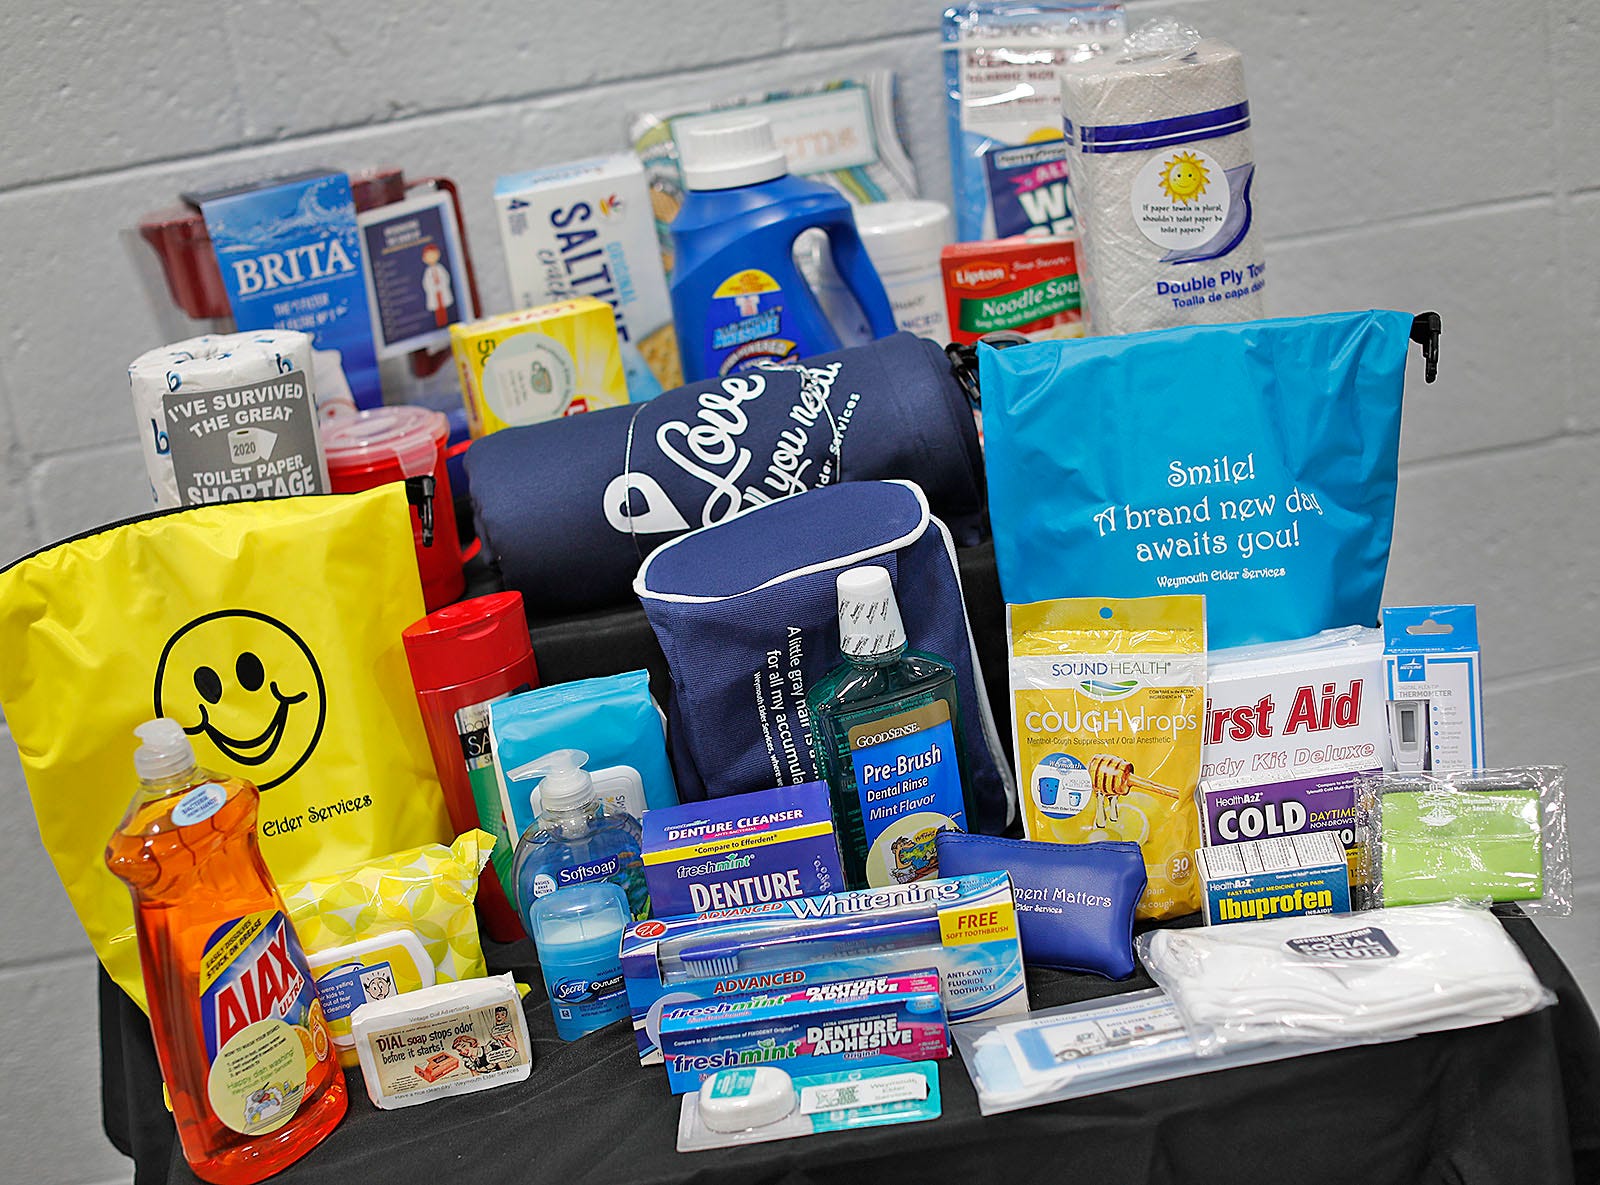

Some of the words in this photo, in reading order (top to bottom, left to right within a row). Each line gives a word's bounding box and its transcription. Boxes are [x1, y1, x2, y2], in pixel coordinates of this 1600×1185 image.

[1151, 205, 1169, 214] paper
[1194, 216, 1212, 224] paper
[231, 238, 357, 296] BRITA
[551, 202, 631, 342] SALTI
[955, 268, 1005, 286] Lipton
[1156, 275, 1217, 295] Double
[1220, 269, 1243, 285] Ply
[981, 288, 1045, 318] Noodle
[1046, 279, 1080, 300] Sou
[1172, 294, 1206, 308] Toalla
[1208, 292, 1222, 303] de
[1225, 286, 1249, 299] capa
[168, 399, 208, 423] I'VE
[212, 383, 304, 411] SURVIVED
[189, 414, 230, 438] THE
[235, 406, 293, 425] GREAT
[829, 392, 861, 456] Services
[233, 441, 256, 457] 2020
[193, 467, 252, 487] TOILET
[256, 454, 304, 478] PAPER
[764, 426, 813, 496] you
[1167, 452, 1256, 488] Smile!
[1093, 505, 1118, 537] A
[1123, 495, 1211, 531] brand
[1219, 494, 1276, 522] new
[1285, 486, 1324, 516] day
[1136, 531, 1228, 563] awaits
[1237, 519, 1301, 559] you!
[1157, 570, 1209, 588] Weymouth
[1210, 568, 1240, 582] Elder
[1242, 566, 1287, 580] Services
[787, 626, 802, 638] A
[766, 649, 782, 669] for
[788, 638, 804, 667] little
[769, 671, 785, 688] all
[1052, 663, 1108, 677] SOUND
[787, 671, 805, 698] gray
[1399, 690, 1453, 698] THERMOMETER
[770, 690, 785, 711] my
[757, 704, 769, 724] Elder
[1025, 710, 1123, 733] COUGH
[1131, 705, 1197, 741] drops
[1203, 693, 1275, 746] irst
[1282, 679, 1364, 736] Aid
[775, 713, 806, 786] accumula
[1026, 736, 1072, 746] Menthol-Cough
[1073, 737, 1115, 746] Suppressant
[1121, 737, 1136, 745] Oral
[1136, 735, 1171, 745] Anesthetic
[863, 743, 942, 785] Pre-Brush
[1201, 757, 1245, 778] ndy
[1252, 750, 1288, 771] Kit
[1294, 743, 1375, 766] Deluxe
[867, 783, 901, 802] Dental
[902, 776, 929, 793] Rinse
[262, 812, 304, 839] Elder
[308, 793, 373, 824] Services
[869, 805, 898, 821] Mint
[899, 793, 937, 814] Flavor
[1310, 807, 1357, 823] DAYTIME
[668, 820, 733, 841] DENTURE
[736, 809, 804, 829] CLEANSER
[1217, 801, 1307, 841] COLD
[731, 841, 740, 849] to
[560, 860, 616, 882] Softsoap
[677, 852, 750, 879] freshmint
[1172, 857, 1189, 873] 30
[689, 869, 804, 913] DENTURE
[1014, 887, 1049, 901] ment
[1052, 887, 1112, 908] Matters
[1244, 887, 1265, 895] RELIEF
[1266, 883, 1295, 892] MEDICINE
[697, 902, 783, 921] ADVANCED
[786, 881, 961, 919] Whitening
[1034, 904, 1063, 914] Services
[1149, 900, 1175, 911] cough
[1219, 889, 1333, 920] Ibuprofen
[958, 911, 998, 929] FREE
[946, 931, 963, 940] SOFT
[964, 925, 1009, 938] TOOTHBRUSH
[216, 919, 300, 1048] AJAX
[713, 970, 806, 994] ADVANCED
[947, 967, 994, 979] ANTI-CAVITY
[948, 977, 984, 987] FLUORIDE
[279, 975, 304, 1017] ULTRA
[321, 985, 335, 994] were
[326, 992, 338, 1000] kids
[558, 980, 588, 999] Secret
[806, 978, 888, 996] DENTURE
[808, 983, 899, 1003] ADHESIVE
[949, 984, 997, 996] TOOTHPASTE
[323, 1000, 332, 1008] out
[409, 1013, 429, 1023] Vintage
[441, 1005, 470, 1017] Advertising
[669, 995, 785, 1020] freshmint
[376, 1035, 406, 1052] DIAL
[407, 1032, 427, 1046] soap
[429, 1028, 453, 1042] stops
[455, 1021, 474, 1035] odor
[674, 1038, 695, 1047] Compare
[711, 1033, 741, 1042] performance
[807, 1018, 898, 1044] DENTURE
[382, 1051, 406, 1065] before
[409, 1047, 415, 1058] it
[416, 1040, 445, 1056] starts!
[812, 1029, 912, 1057] ADHESIVE
[843, 1048, 880, 1060] Original
[674, 1041, 796, 1073] freshmint
[497, 1067, 520, 1077] Services
